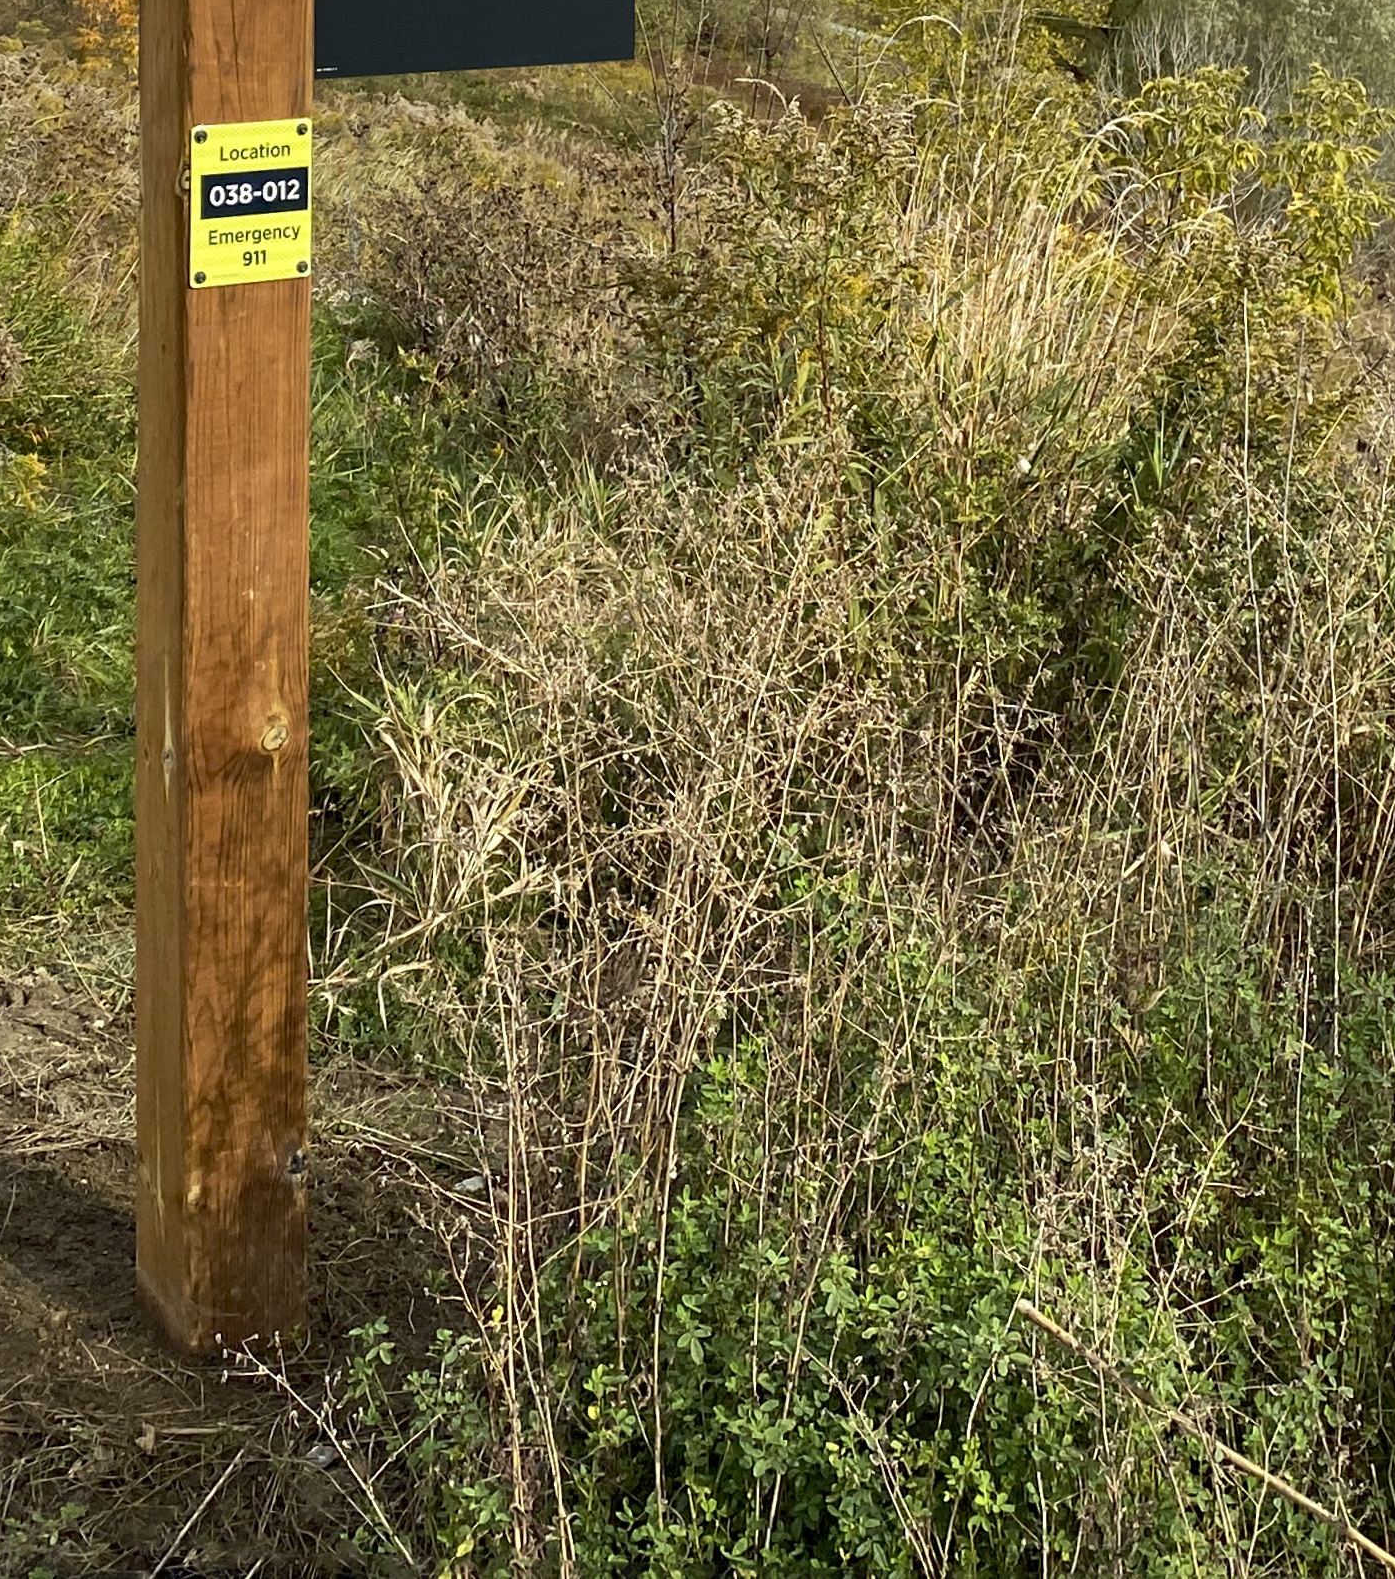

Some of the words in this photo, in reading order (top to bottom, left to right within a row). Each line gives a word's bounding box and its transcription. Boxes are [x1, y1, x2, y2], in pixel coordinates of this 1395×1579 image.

[220, 142, 291, 161] Location
[209, 178, 300, 207] 038-012
[208, 225, 301, 245] Emergency
[242, 250, 267, 266] 911
